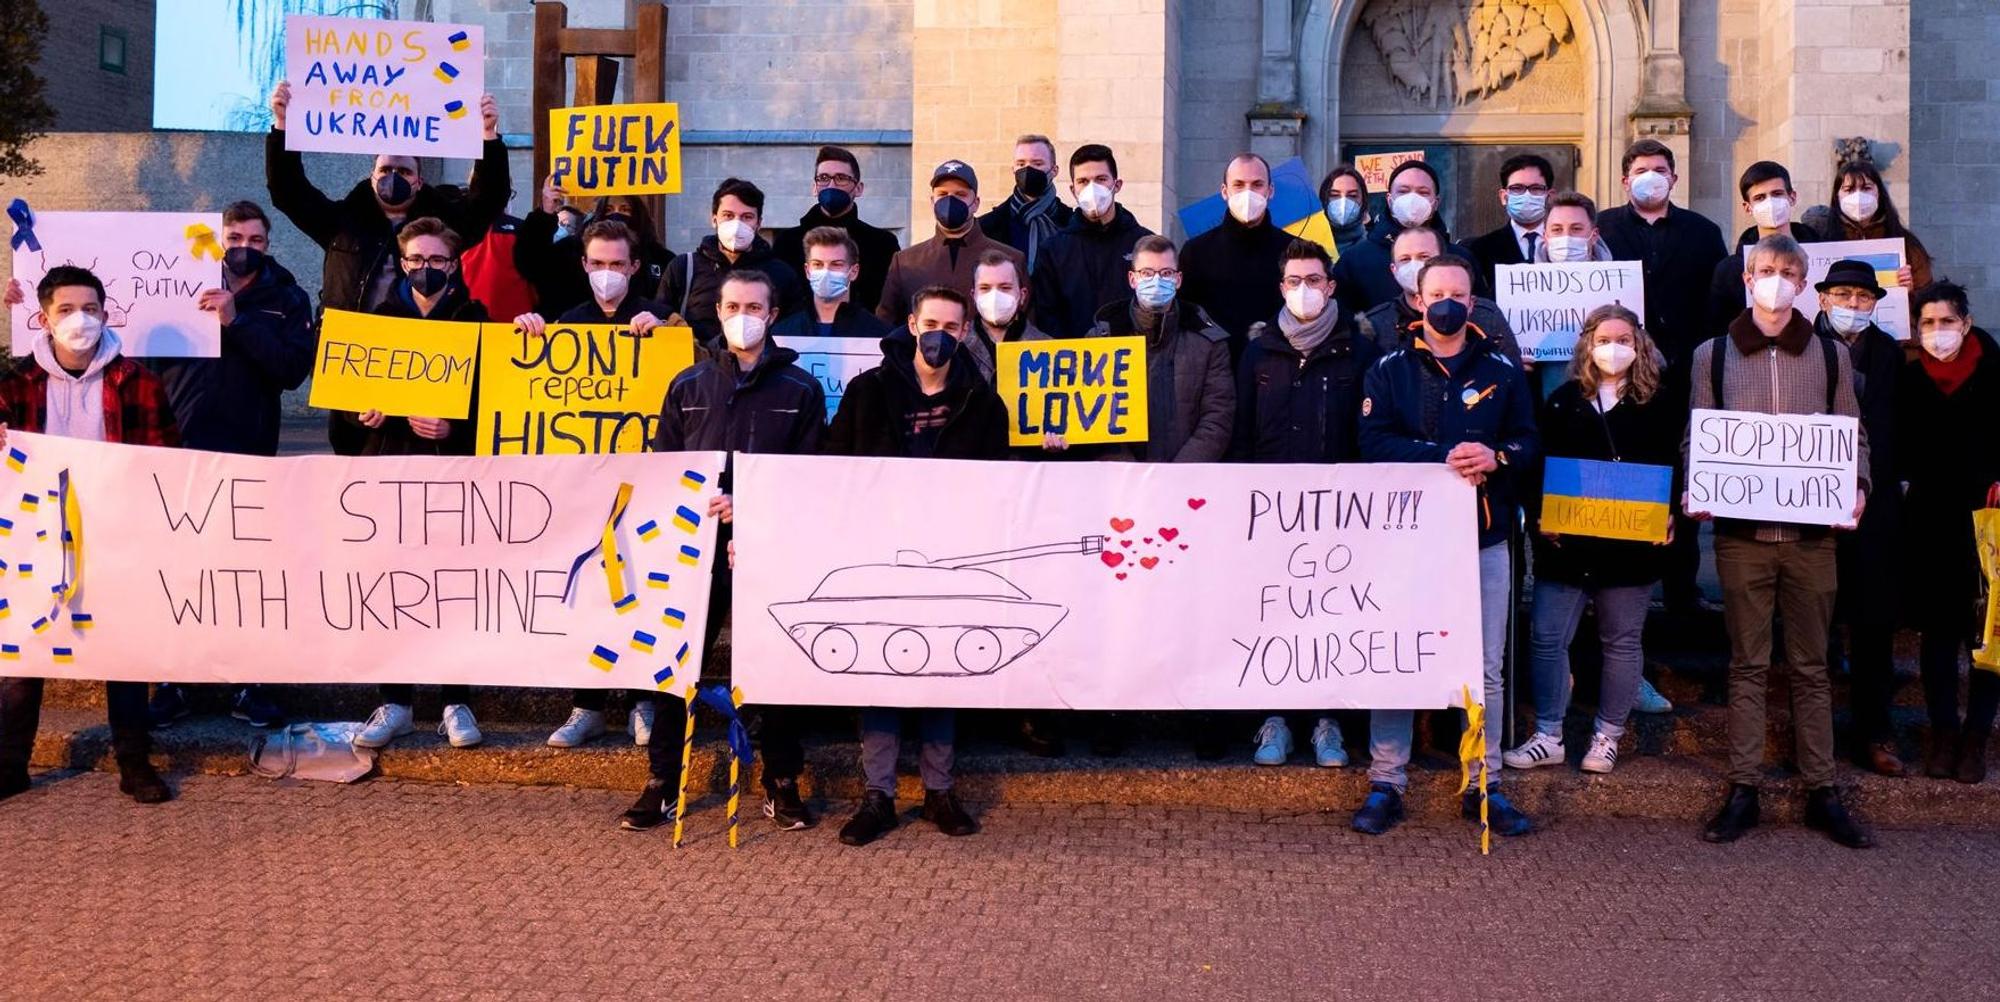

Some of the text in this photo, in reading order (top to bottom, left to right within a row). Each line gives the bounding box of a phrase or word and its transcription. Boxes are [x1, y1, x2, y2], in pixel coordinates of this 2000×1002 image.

[306, 27, 427, 63] HANDS
[304, 61, 405, 87] AWAY
[329, 88, 412, 111] FROM
[306, 110, 440, 142] UKRAINE
[566, 114, 675, 154] FUCK
[553, 156, 668, 189] PUTIN
[1360, 157, 1383, 171] WE
[132, 250, 179, 270] ON
[131, 277, 203, 298] PUTIN
[1510, 268, 1632, 296] HANDS OFF
[1507, 307, 1586, 336] UKRAIN
[322, 340, 471, 385] FREEDOM
[1019, 349, 1132, 388] MAKE
[529, 376, 629, 406] repeat
[1018, 391, 1129, 435] LOVE
[492, 410, 661, 455] HISTOR
[1699, 417, 1853, 463] STOP PUTIN
[1691, 470, 1843, 510] STOP WAR
[153, 473, 552, 546] WE STAND
[1247, 489, 1374, 541] PUTIN
[1557, 502, 1649, 532] UKRAINE
[1287, 542, 1352, 579] GO
[159, 568, 568, 636] WITH UKRAINE
[1260, 581, 1382, 623] FUCK
[1231, 630, 1437, 688] YOURSELF
